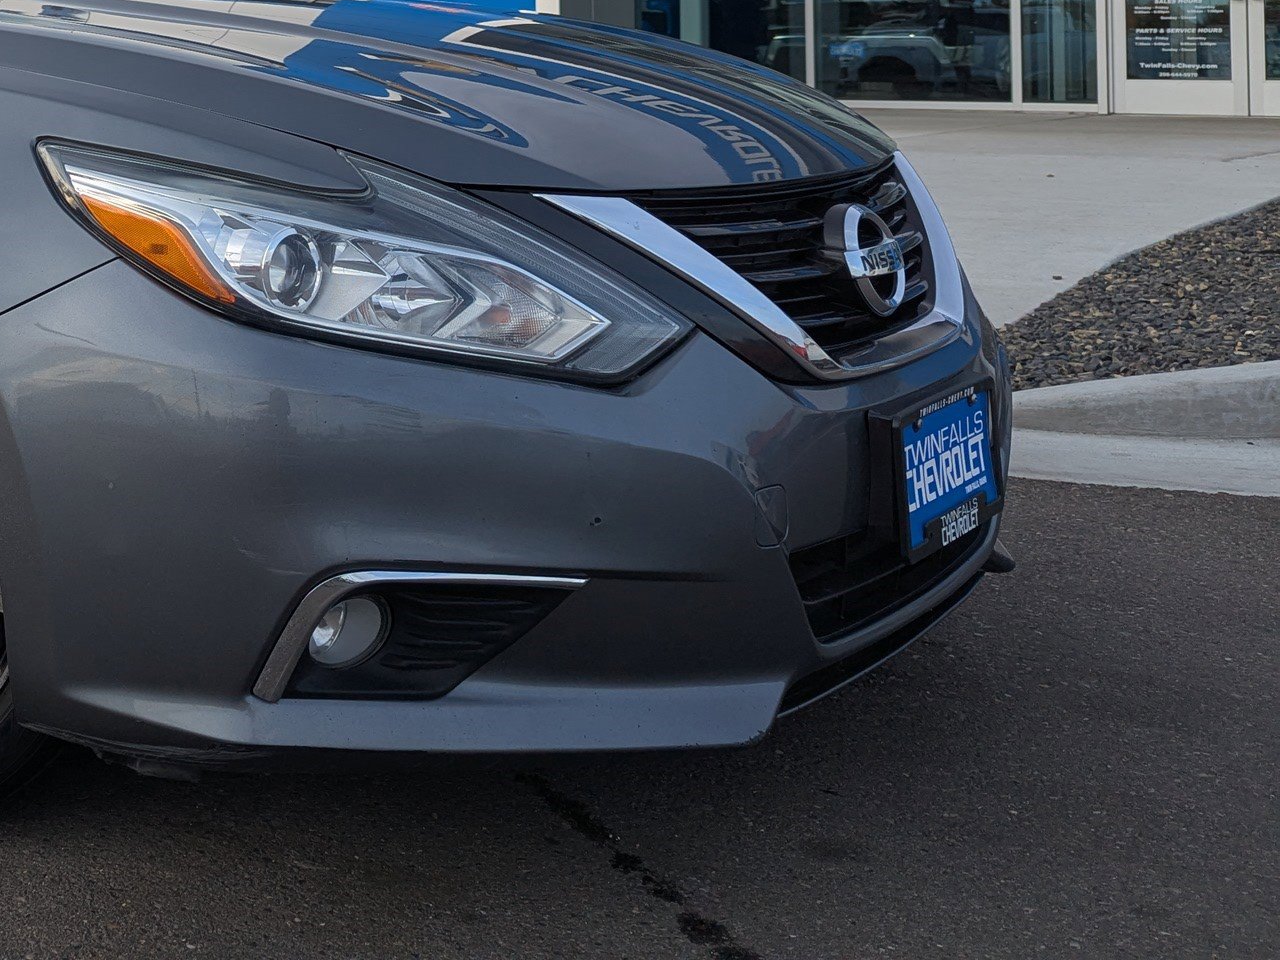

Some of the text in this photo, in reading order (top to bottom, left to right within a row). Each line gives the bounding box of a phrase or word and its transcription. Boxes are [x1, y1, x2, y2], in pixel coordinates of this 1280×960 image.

[1139, 62, 1218, 70] TwinFalls-Chevy.com
[904, 411, 983, 471] TWINFALLS
[940, 498, 978, 528] TWINFALLS
[942, 509, 978, 546] CHEVROLET
